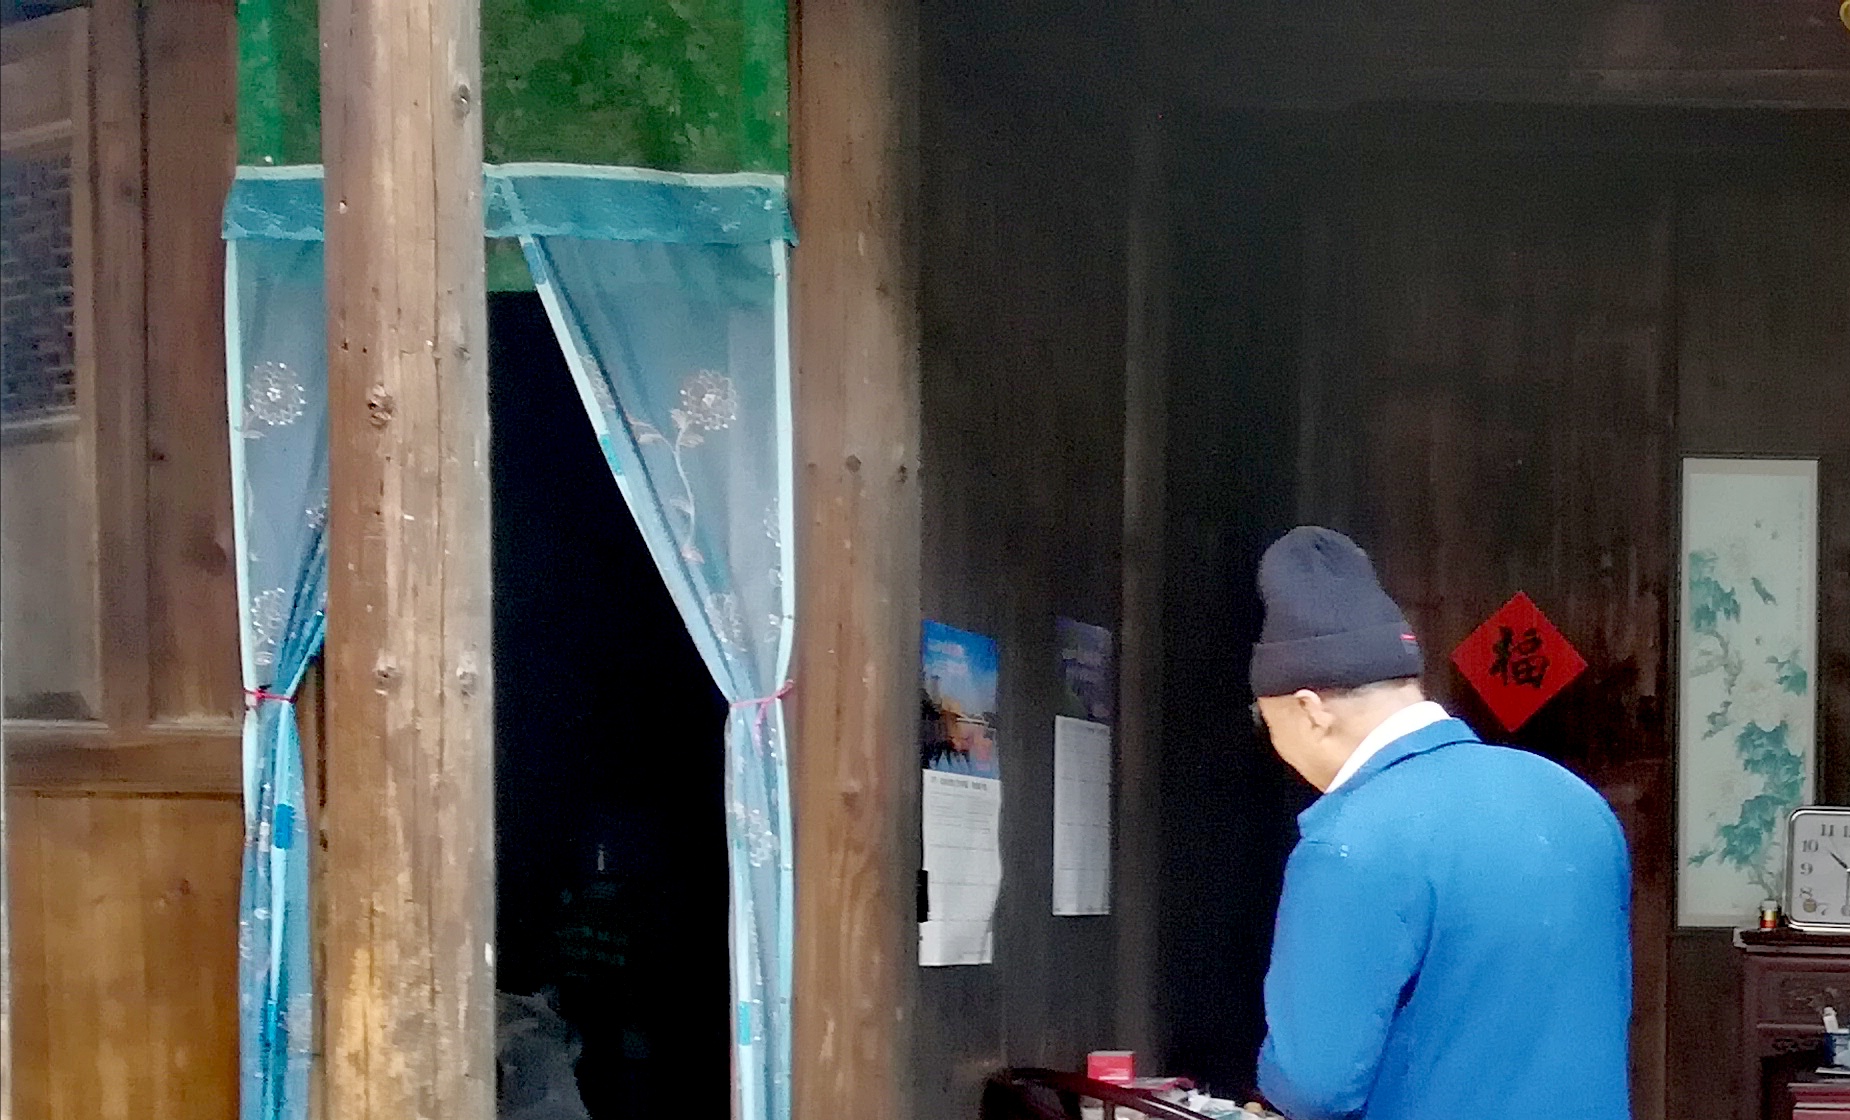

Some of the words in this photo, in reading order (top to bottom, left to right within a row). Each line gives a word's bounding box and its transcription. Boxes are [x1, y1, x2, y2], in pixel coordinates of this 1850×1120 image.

[1488, 625, 1551, 689] 福
[1820, 823, 1835, 837] 11
[1801, 840, 1819, 853] 10
[1800, 862, 1814, 876] 9
[1816, 902, 1831, 916] 7
